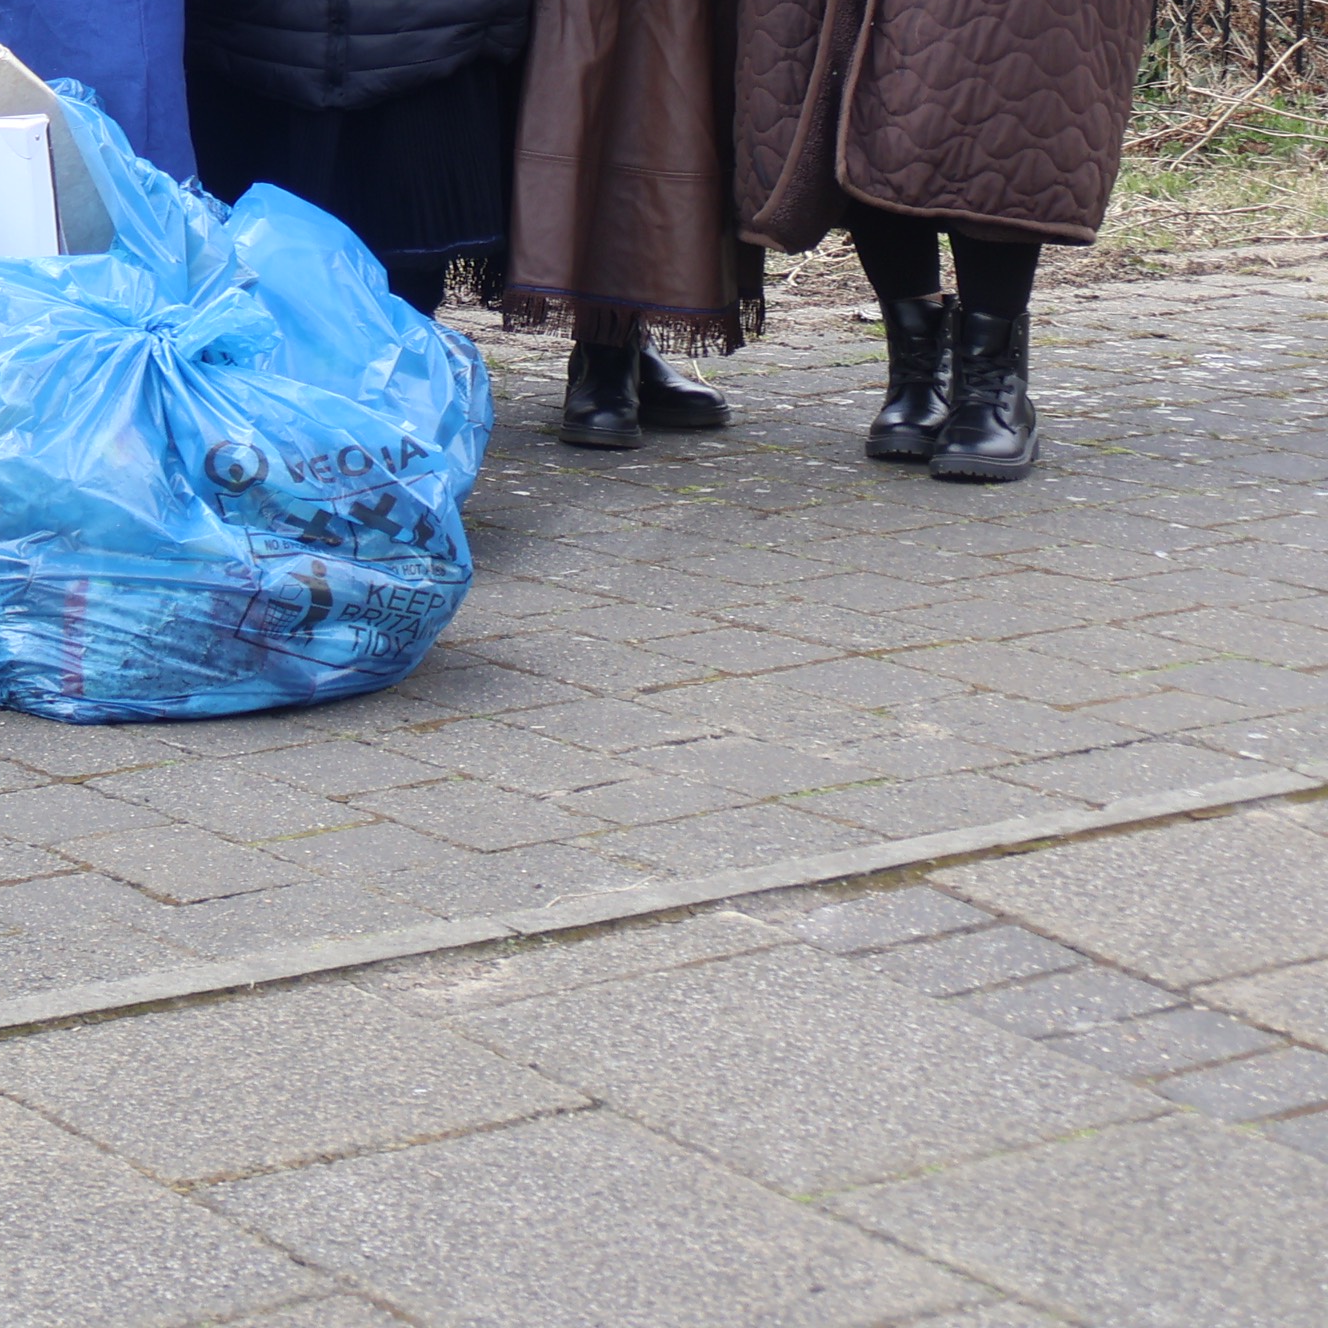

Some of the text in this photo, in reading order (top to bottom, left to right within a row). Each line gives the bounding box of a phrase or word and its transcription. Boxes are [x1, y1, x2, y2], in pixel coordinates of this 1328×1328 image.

[281, 434, 430, 484] VEOIA
[366, 582, 446, 617] KEEP
[348, 624, 415, 660] TIDY
